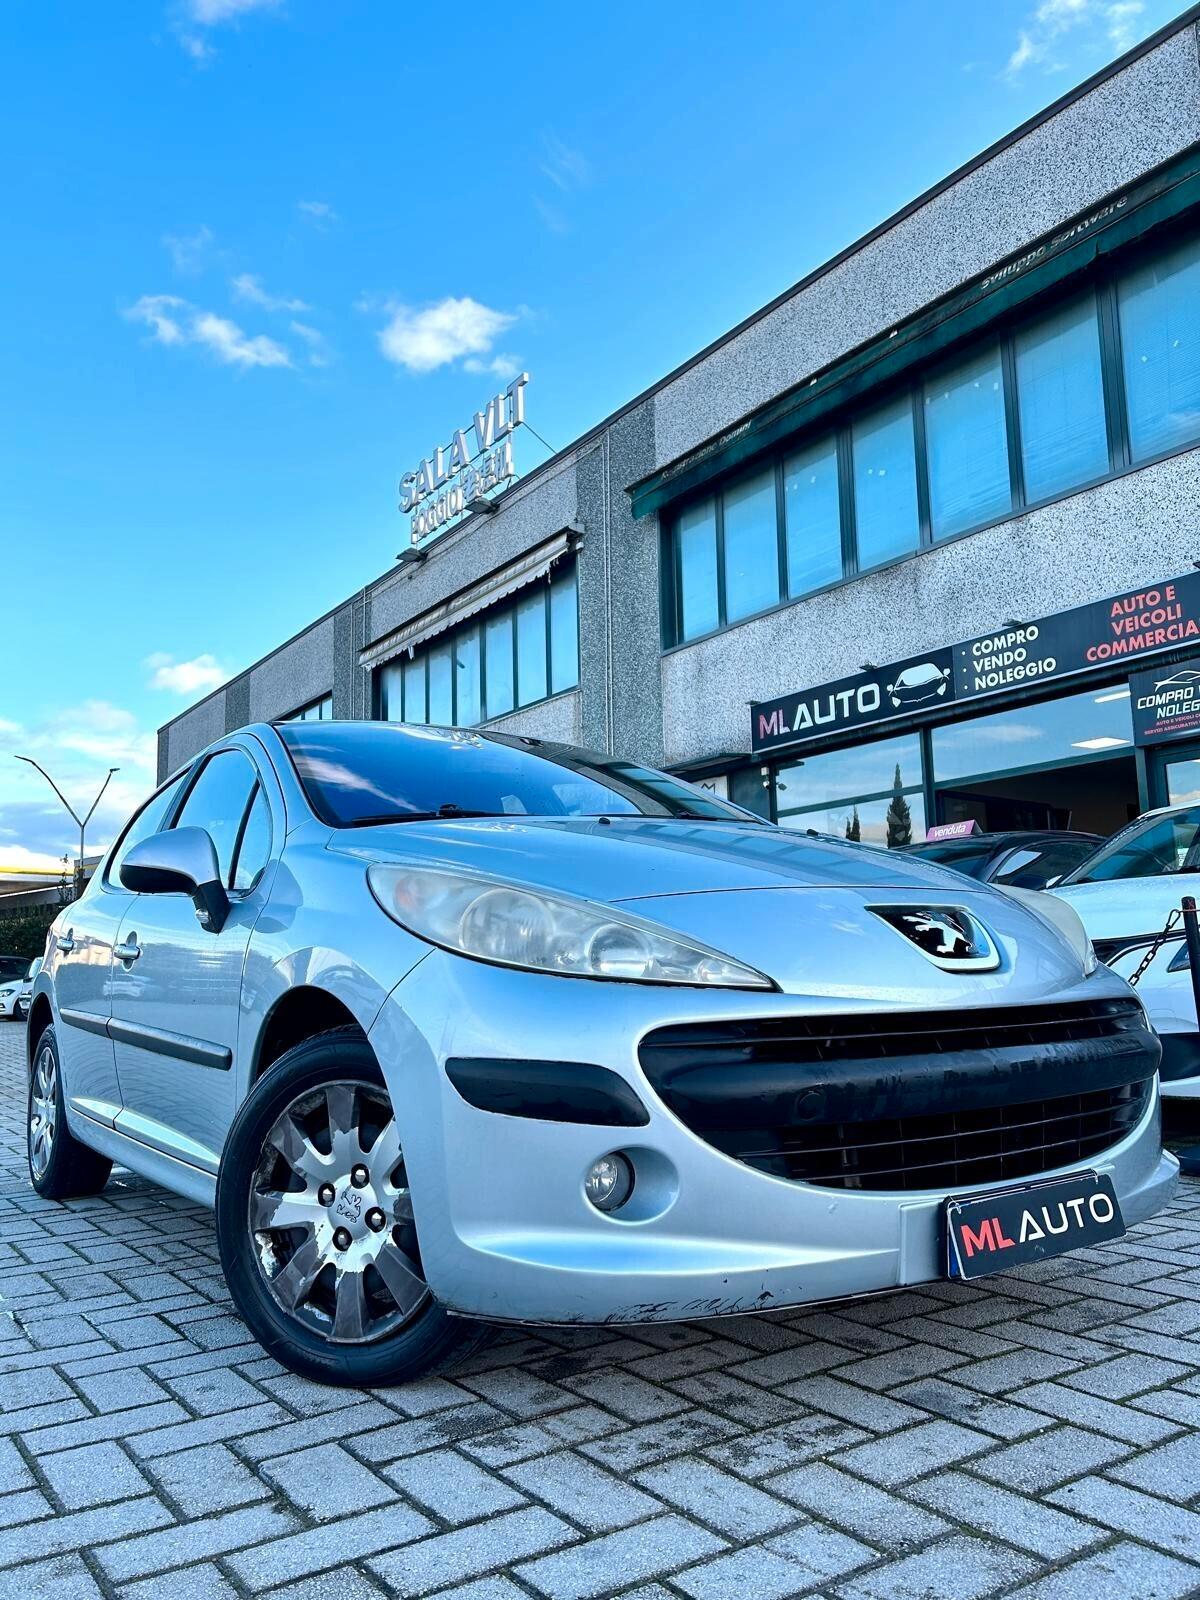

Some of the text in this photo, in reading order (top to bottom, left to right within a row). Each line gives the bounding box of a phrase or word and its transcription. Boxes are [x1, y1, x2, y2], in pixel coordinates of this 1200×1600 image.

[980, 195, 1128, 290] Sviluppo Software
[399, 428, 471, 513] SALA
[473, 372, 529, 454] VLT
[1111, 585, 1176, 618] AUTO E
[1111, 603, 1182, 636] VEICOLI
[971, 625, 1039, 656] COMPRO
[1087, 619, 1200, 661] COMMERCIA
[973, 647, 1027, 673] VENDO
[974, 657, 1056, 690] NOLEGGIO
[759, 682, 880, 740] ML AUTO
[1137, 686, 1194, 710] COMPRO
[1175, 713, 1194, 722] VEICOLI
[934, 824, 967, 838] venduta
[960, 1192, 1115, 1258] ML AUTO
